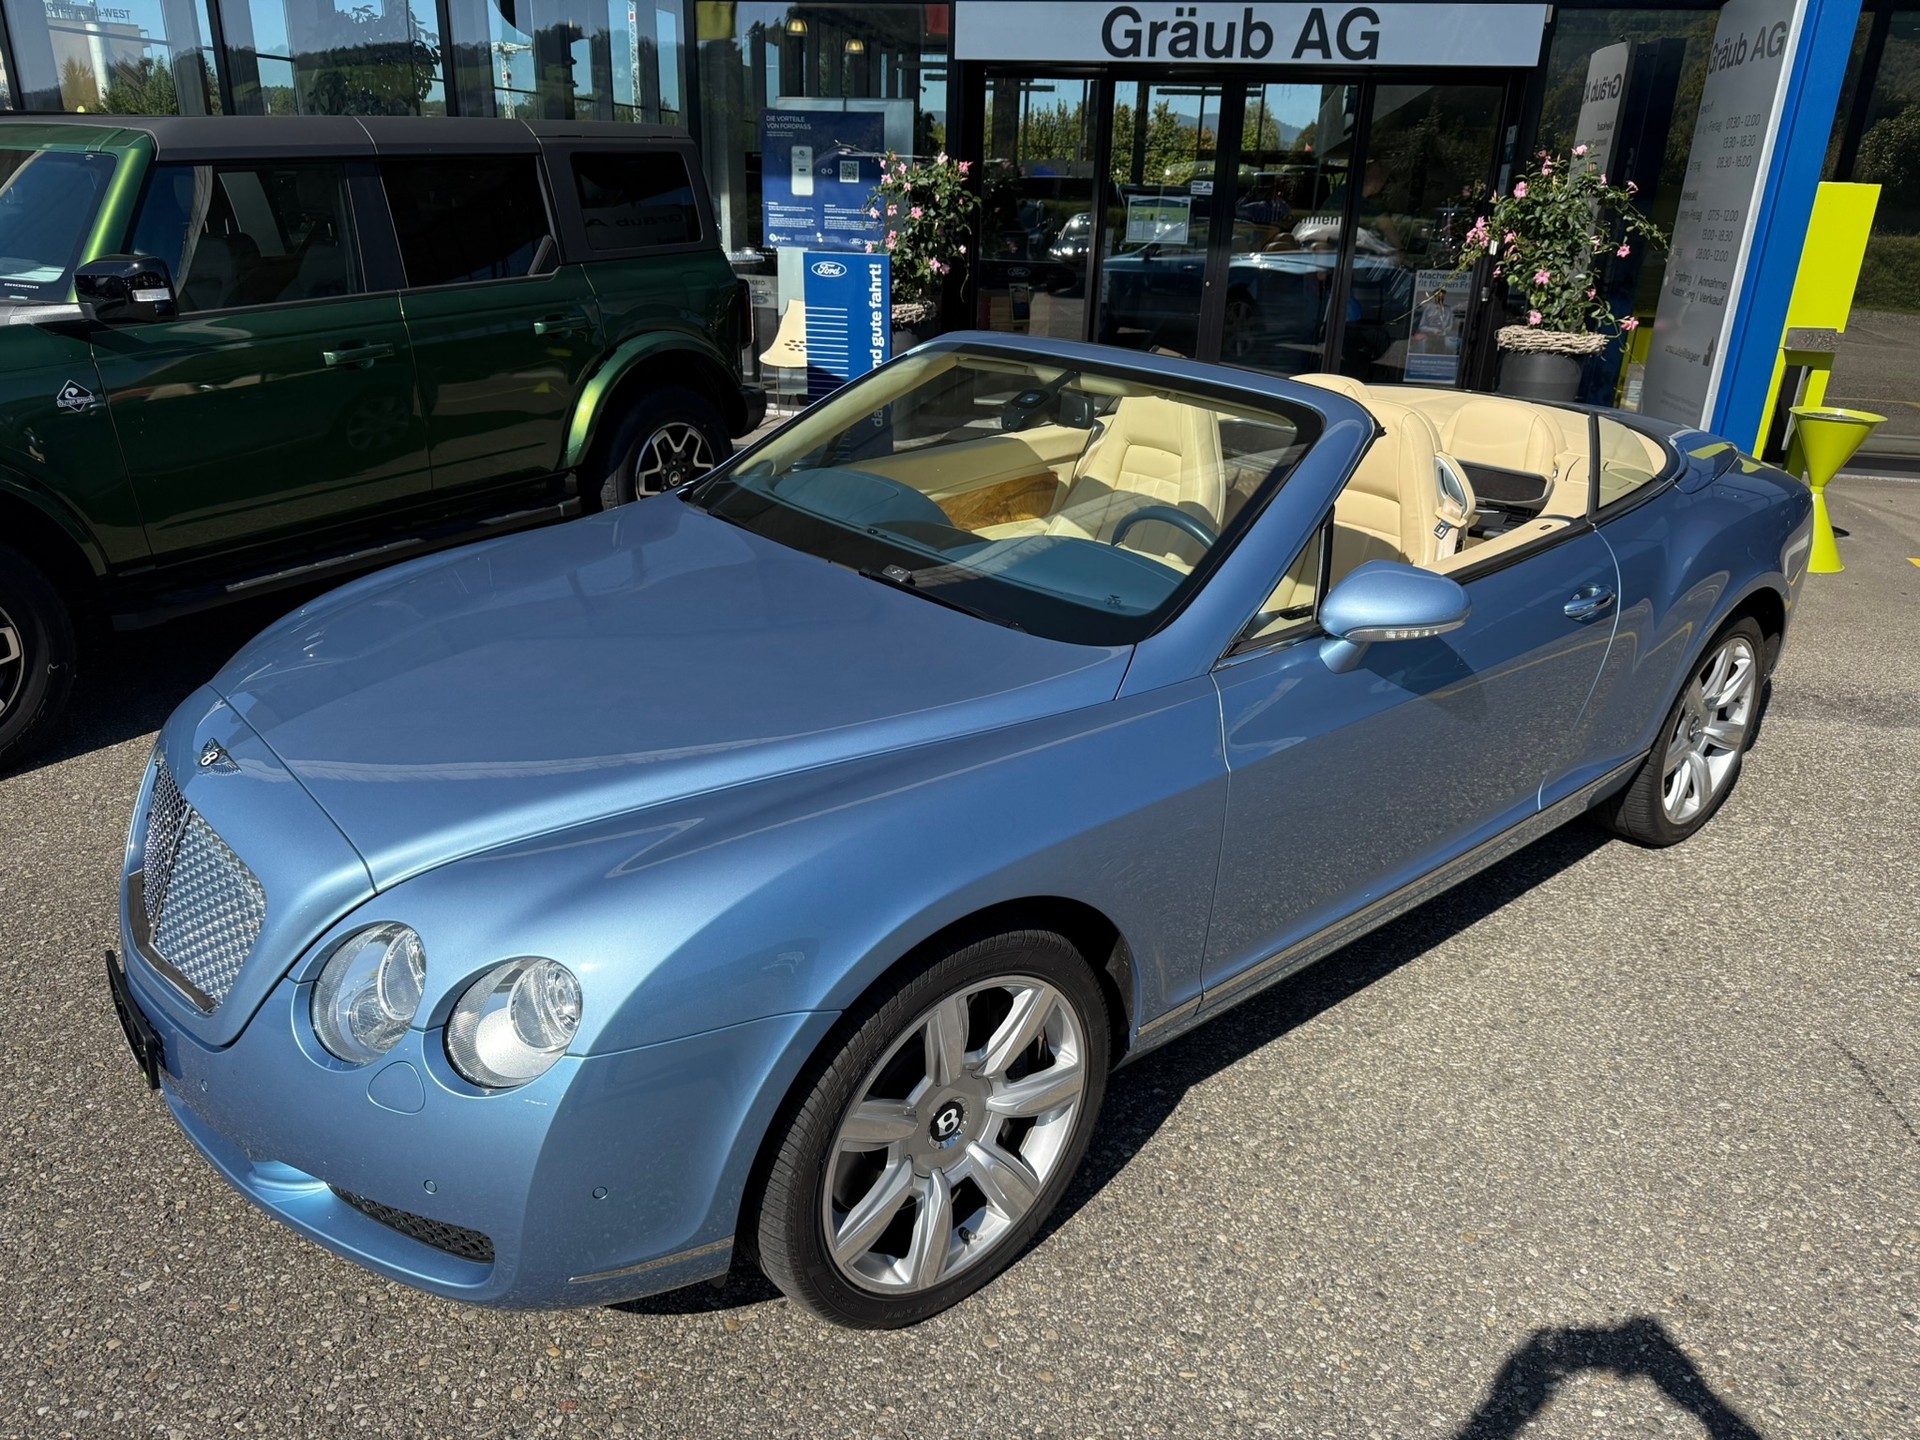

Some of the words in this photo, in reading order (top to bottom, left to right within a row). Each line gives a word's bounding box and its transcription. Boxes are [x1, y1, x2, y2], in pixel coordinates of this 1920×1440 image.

[1101, 5, 1274, 60] Gräub
[1291, 6, 1381, 61] AG
[1708, 32, 1748, 75] Gräub
[1750, 21, 1787, 62] AG
[766, 122, 779, 130] VON
[776, 115, 805, 123] VORTEILE
[816, 262, 842, 276] Ford
[1418, 271, 1448, 280] Mache
[868, 263, 883, 309] fahrt!
[1698, 275, 1728, 291] Annahme
[1699, 292, 1724, 306] Verkauf
[869, 310, 885, 348] gute
[869, 349, 883, 370] nd
[937, 1108, 960, 1137] B
